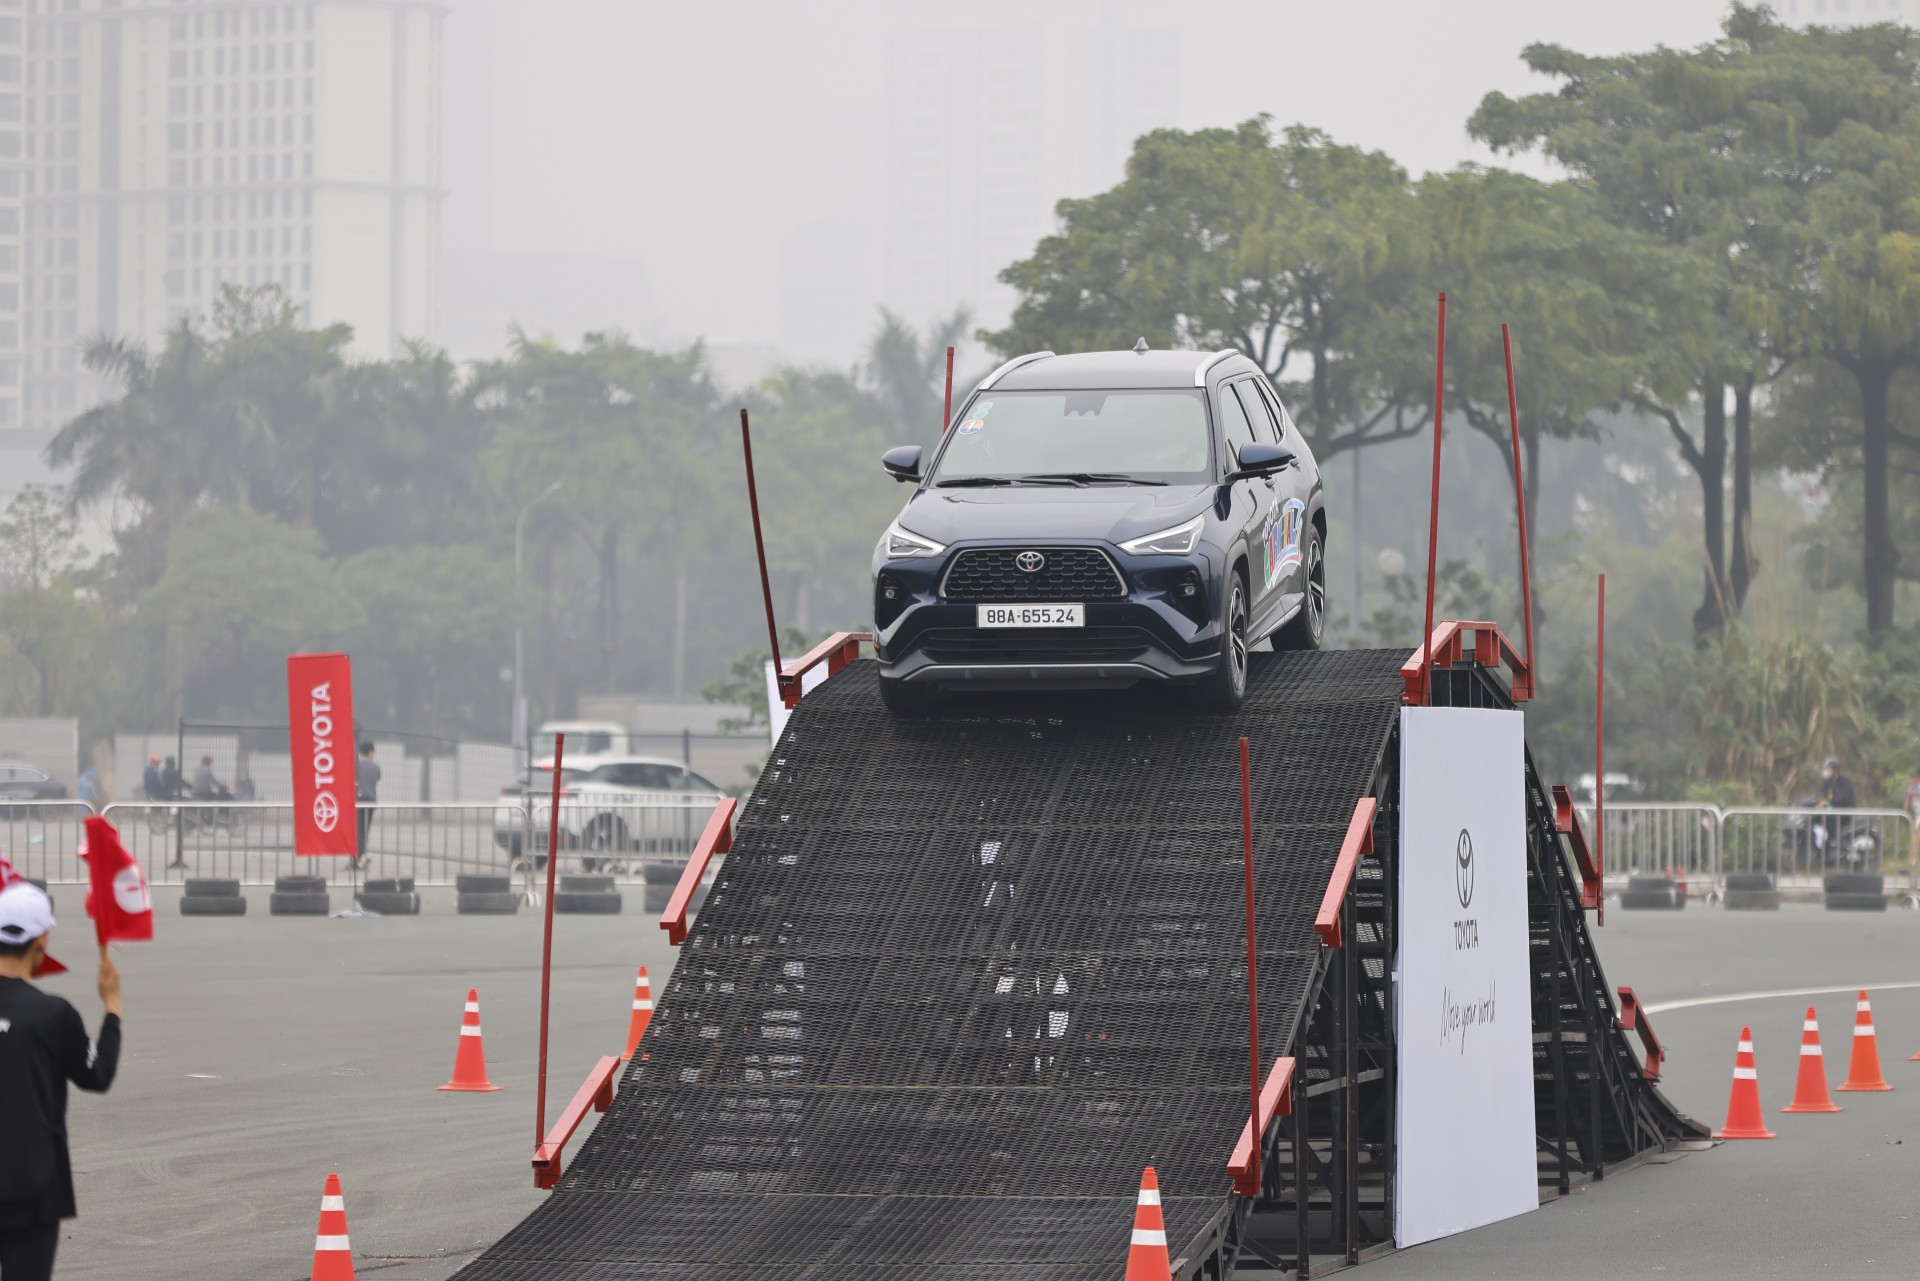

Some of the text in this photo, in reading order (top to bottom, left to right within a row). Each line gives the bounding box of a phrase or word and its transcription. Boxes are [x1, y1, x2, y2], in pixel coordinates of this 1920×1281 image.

[987, 608, 1075, 624] 88A-655.24
[311, 681, 335, 790] TOYOTA
[1454, 919, 1478, 950] TOYOTA
[1461, 1002, 1477, 1056] your
[1478, 979, 1496, 1027] world
